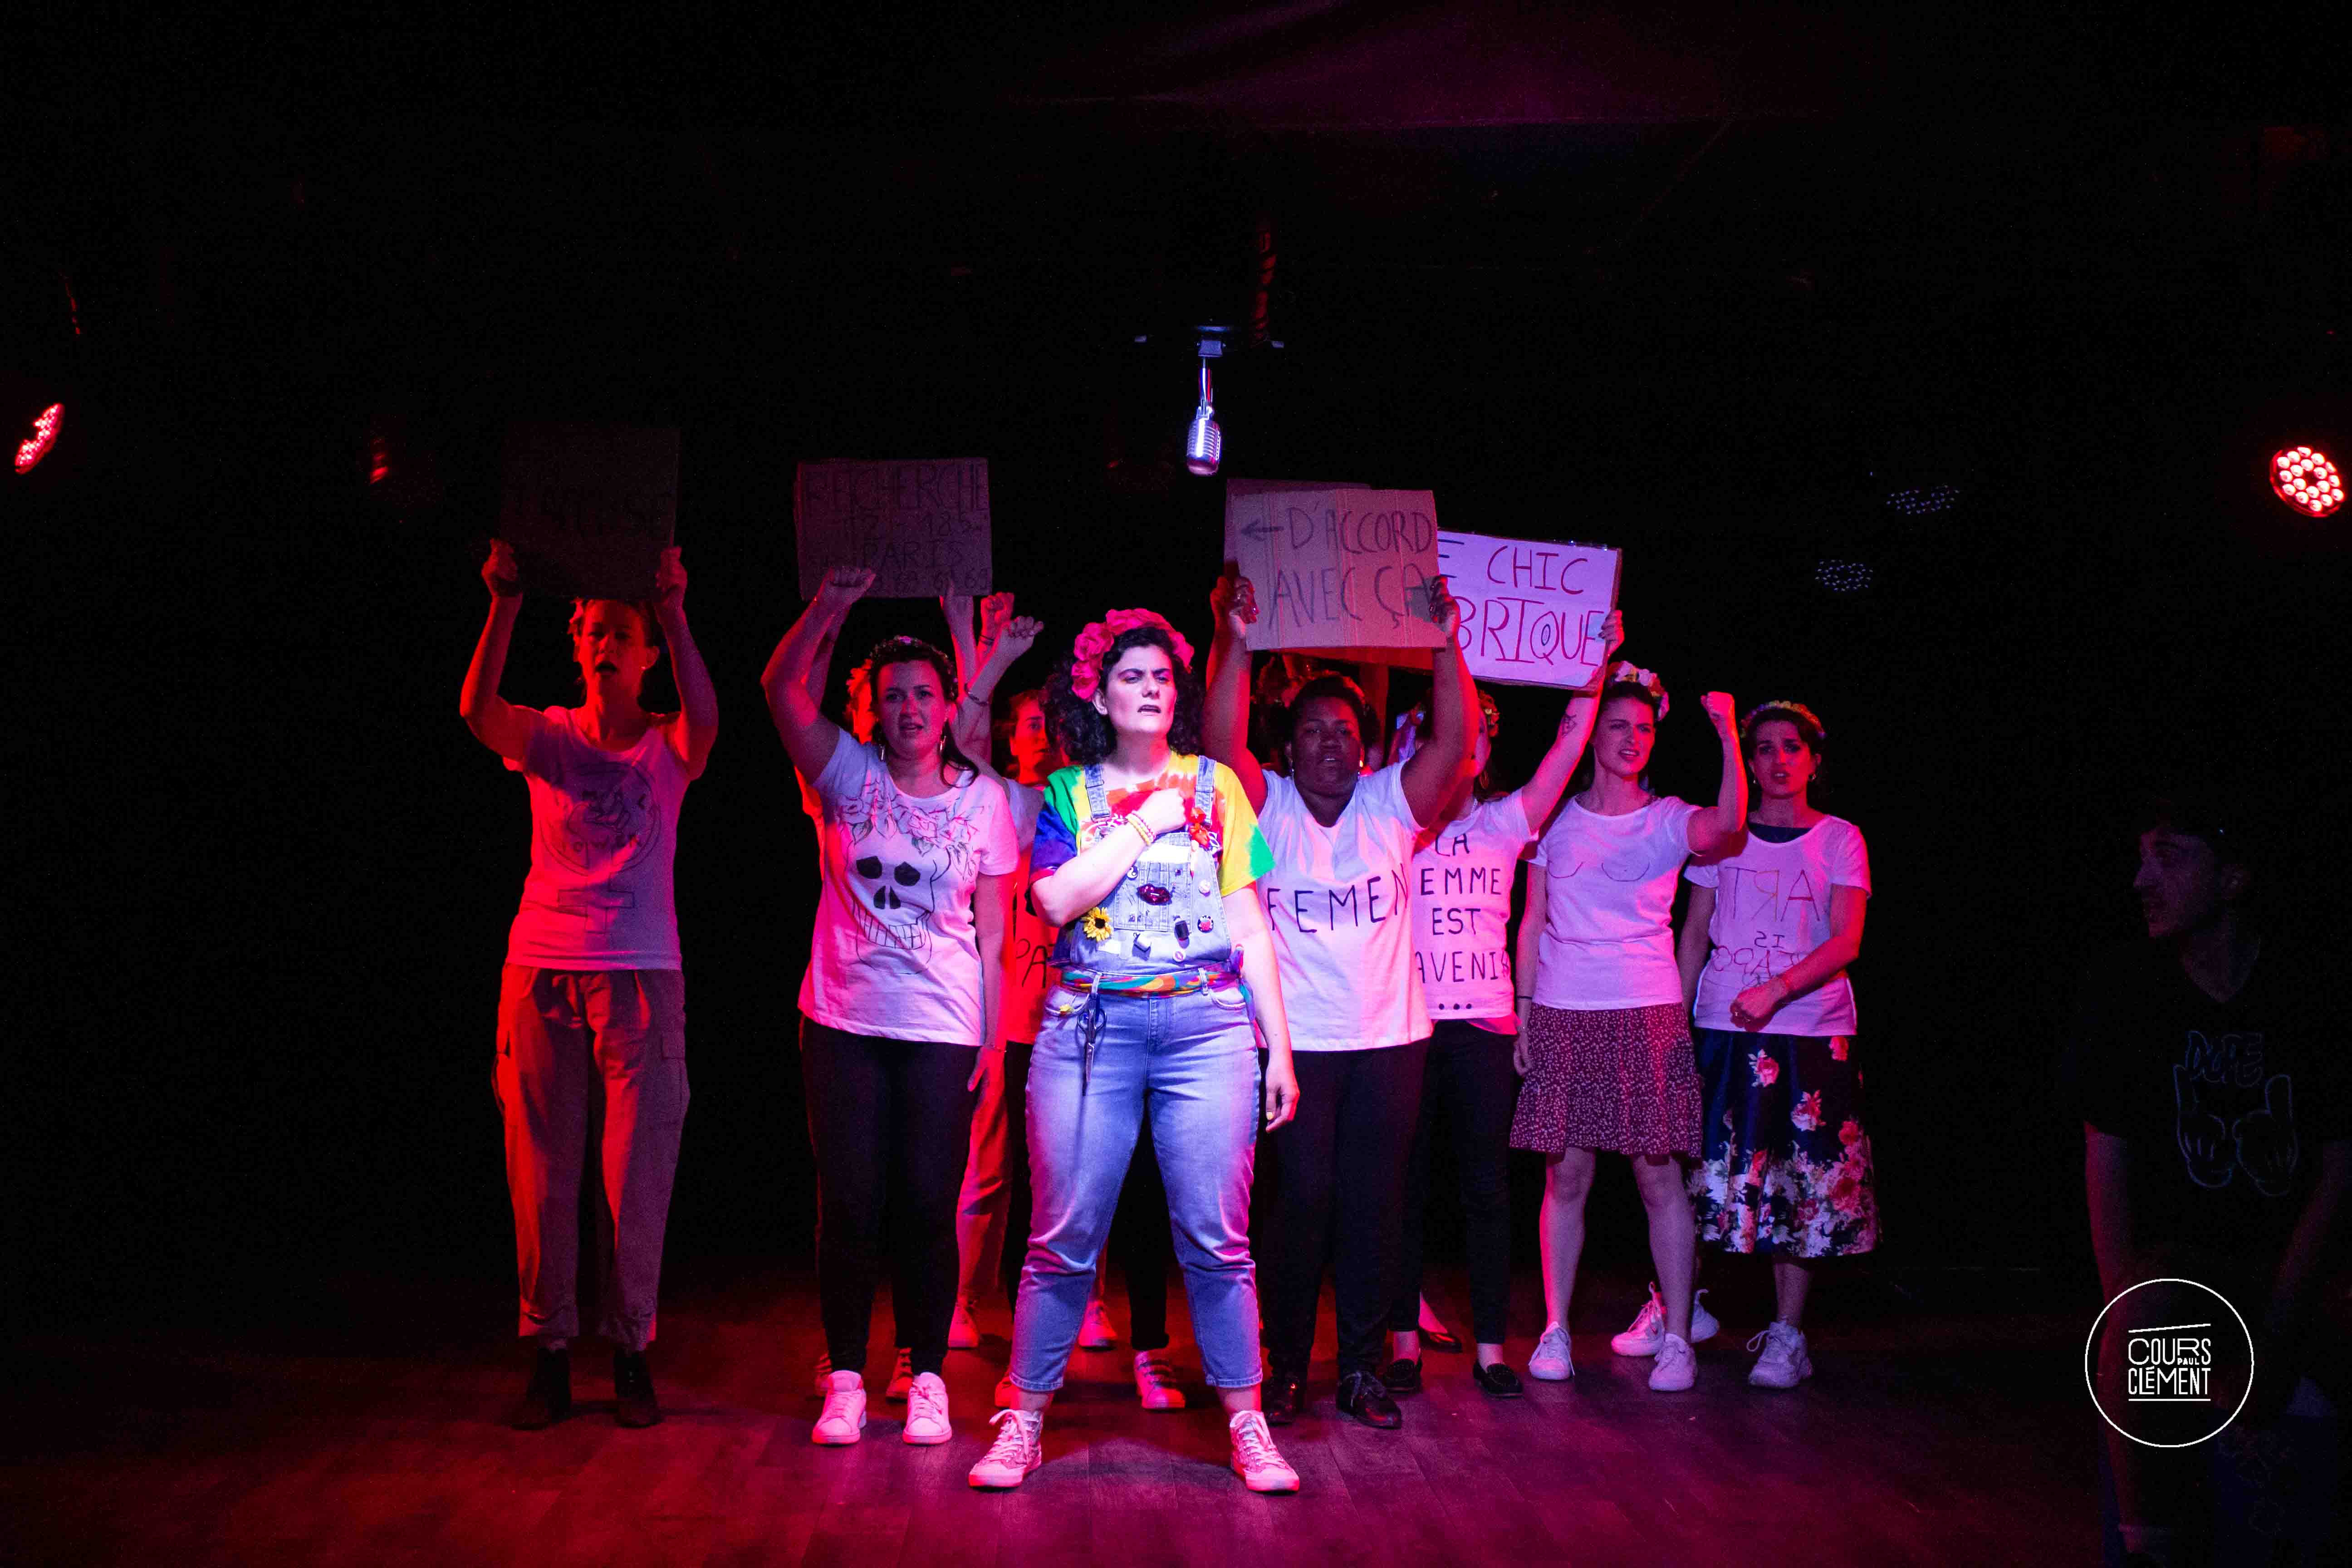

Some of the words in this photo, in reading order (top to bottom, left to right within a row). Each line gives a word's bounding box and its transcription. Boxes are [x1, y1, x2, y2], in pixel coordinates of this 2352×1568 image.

[1287, 502, 1432, 554] D'ACCORD
[1486, 545, 1588, 595] CHIC
[1269, 568, 1363, 630] AVEC
[1267, 863, 1409, 933] FEMEN
[1432, 908, 1481, 935] EST
